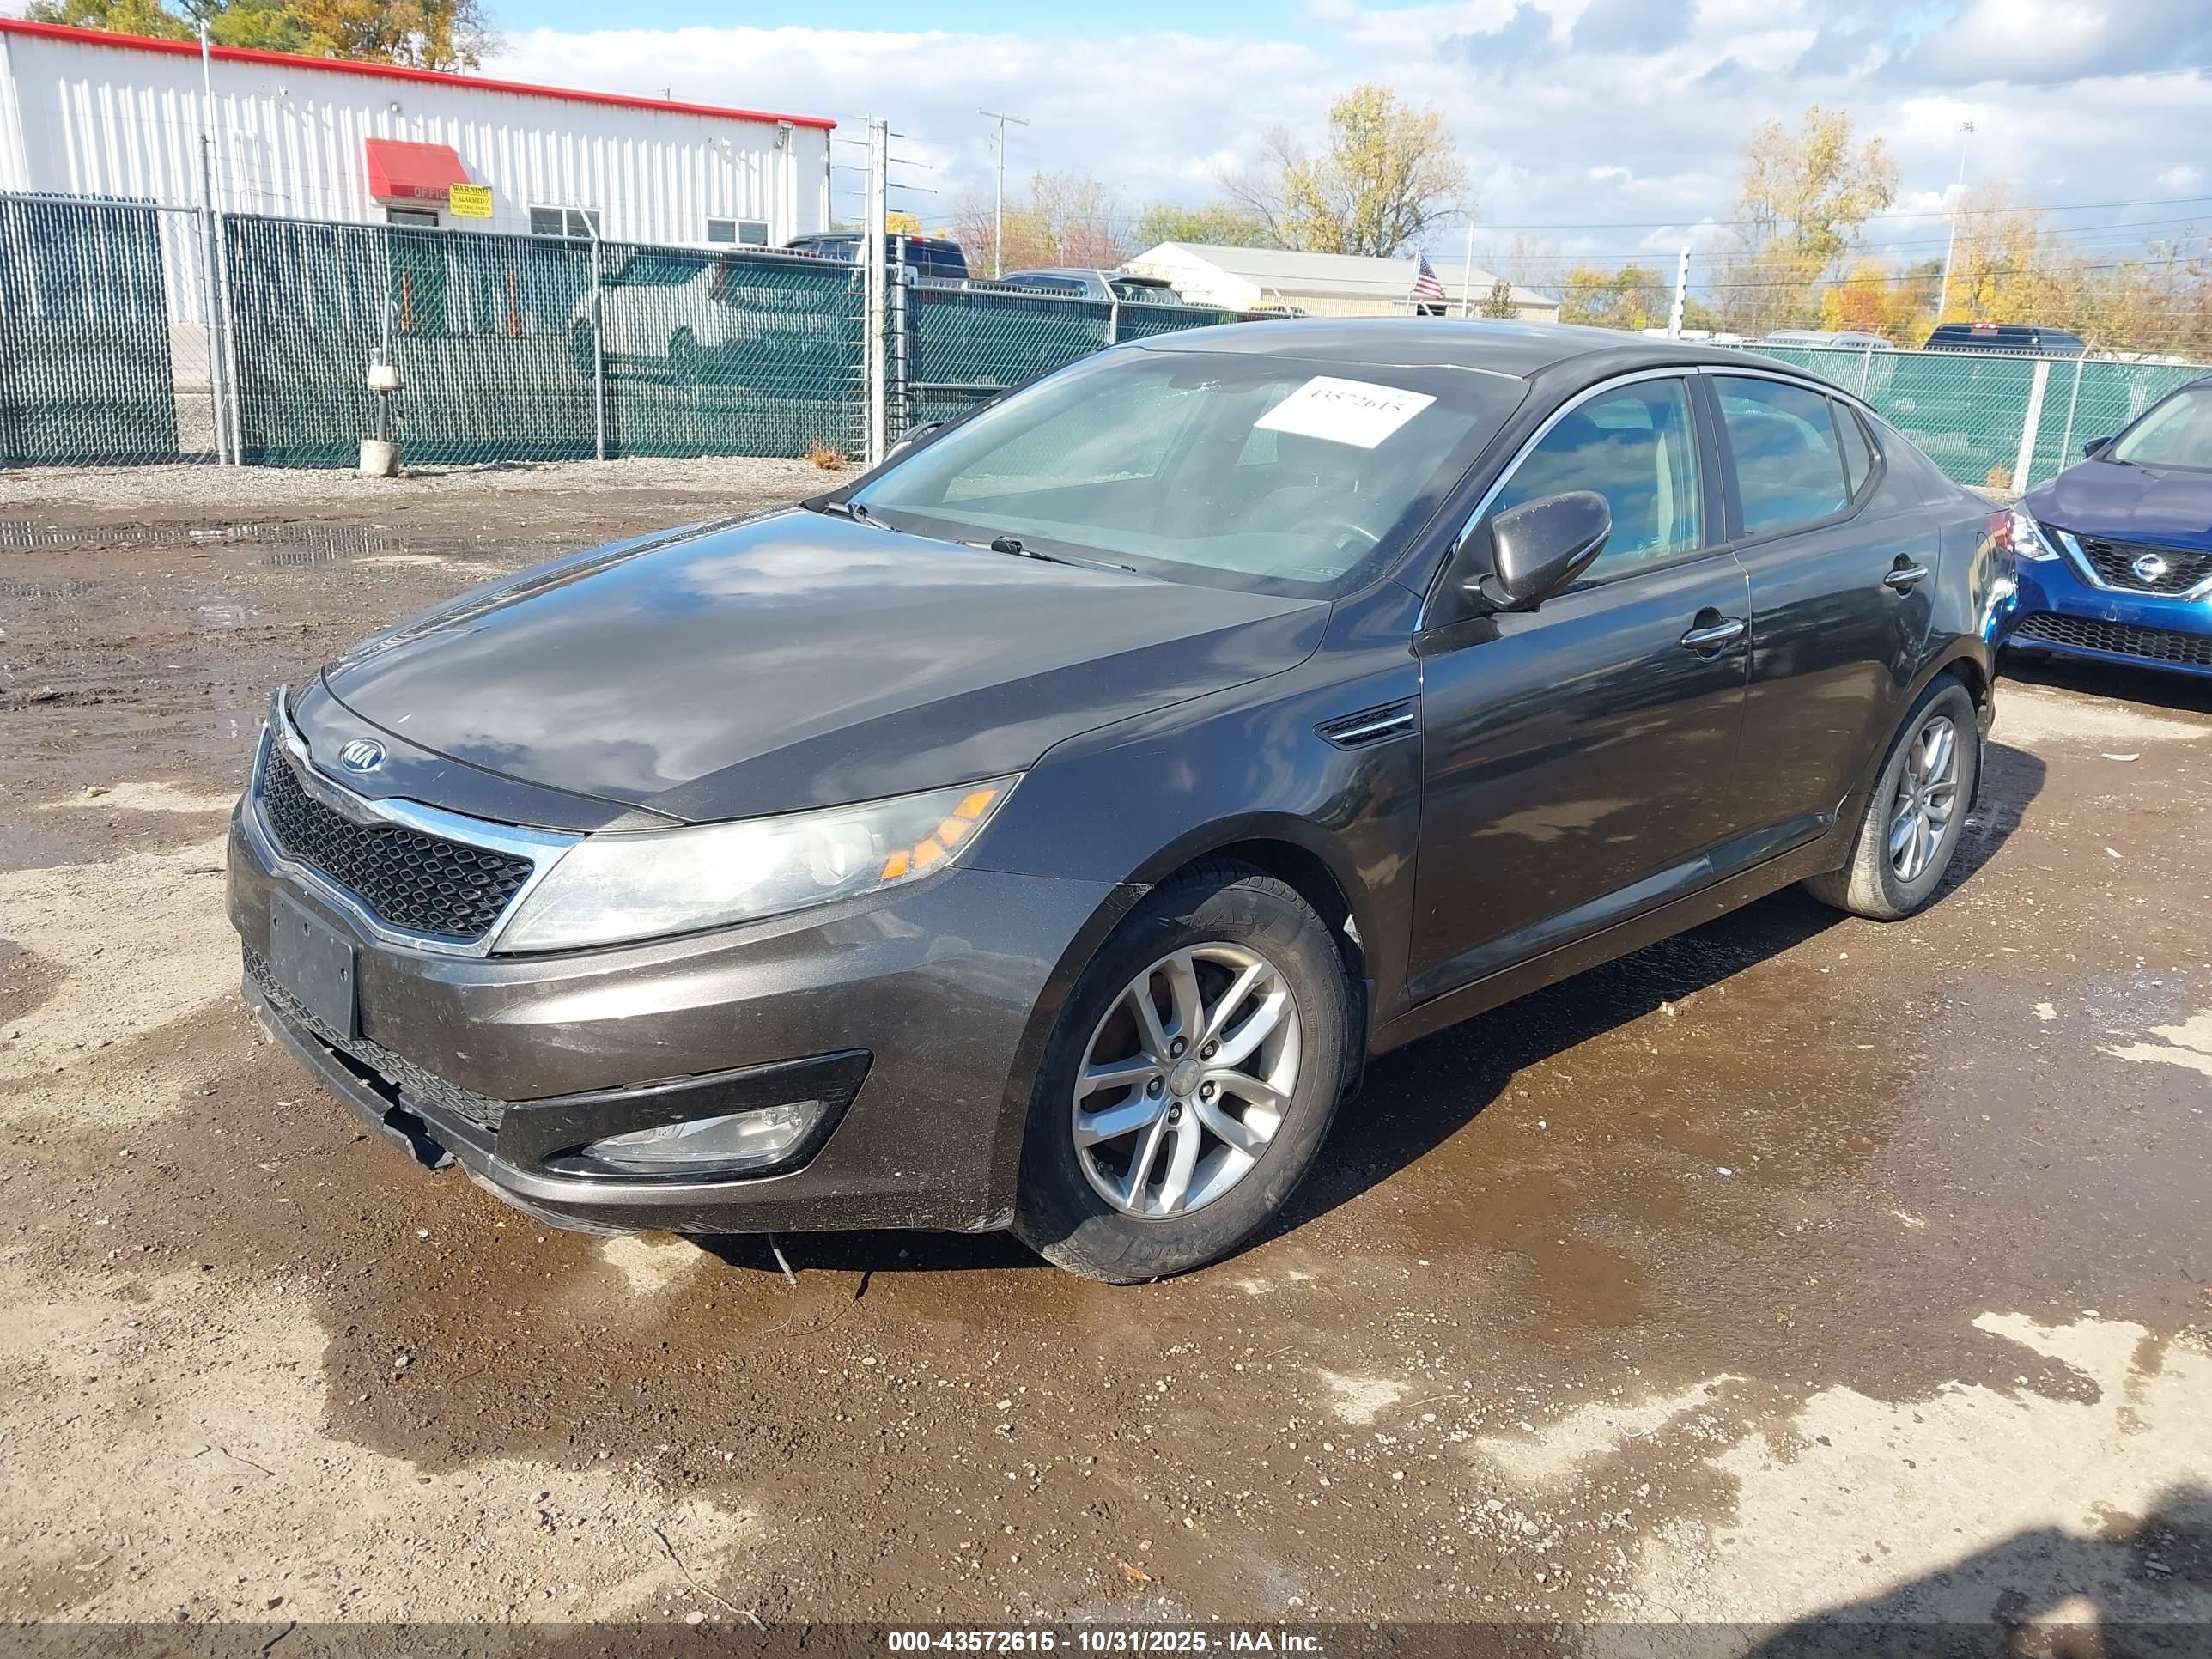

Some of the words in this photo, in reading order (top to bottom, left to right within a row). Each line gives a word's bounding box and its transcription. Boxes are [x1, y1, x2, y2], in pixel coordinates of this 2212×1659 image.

[414, 186, 449, 199] OFFIC
[453, 185, 489, 195] WARNING
[458, 196, 485, 204] ALARMED
[343, 741, 378, 769] KIA
